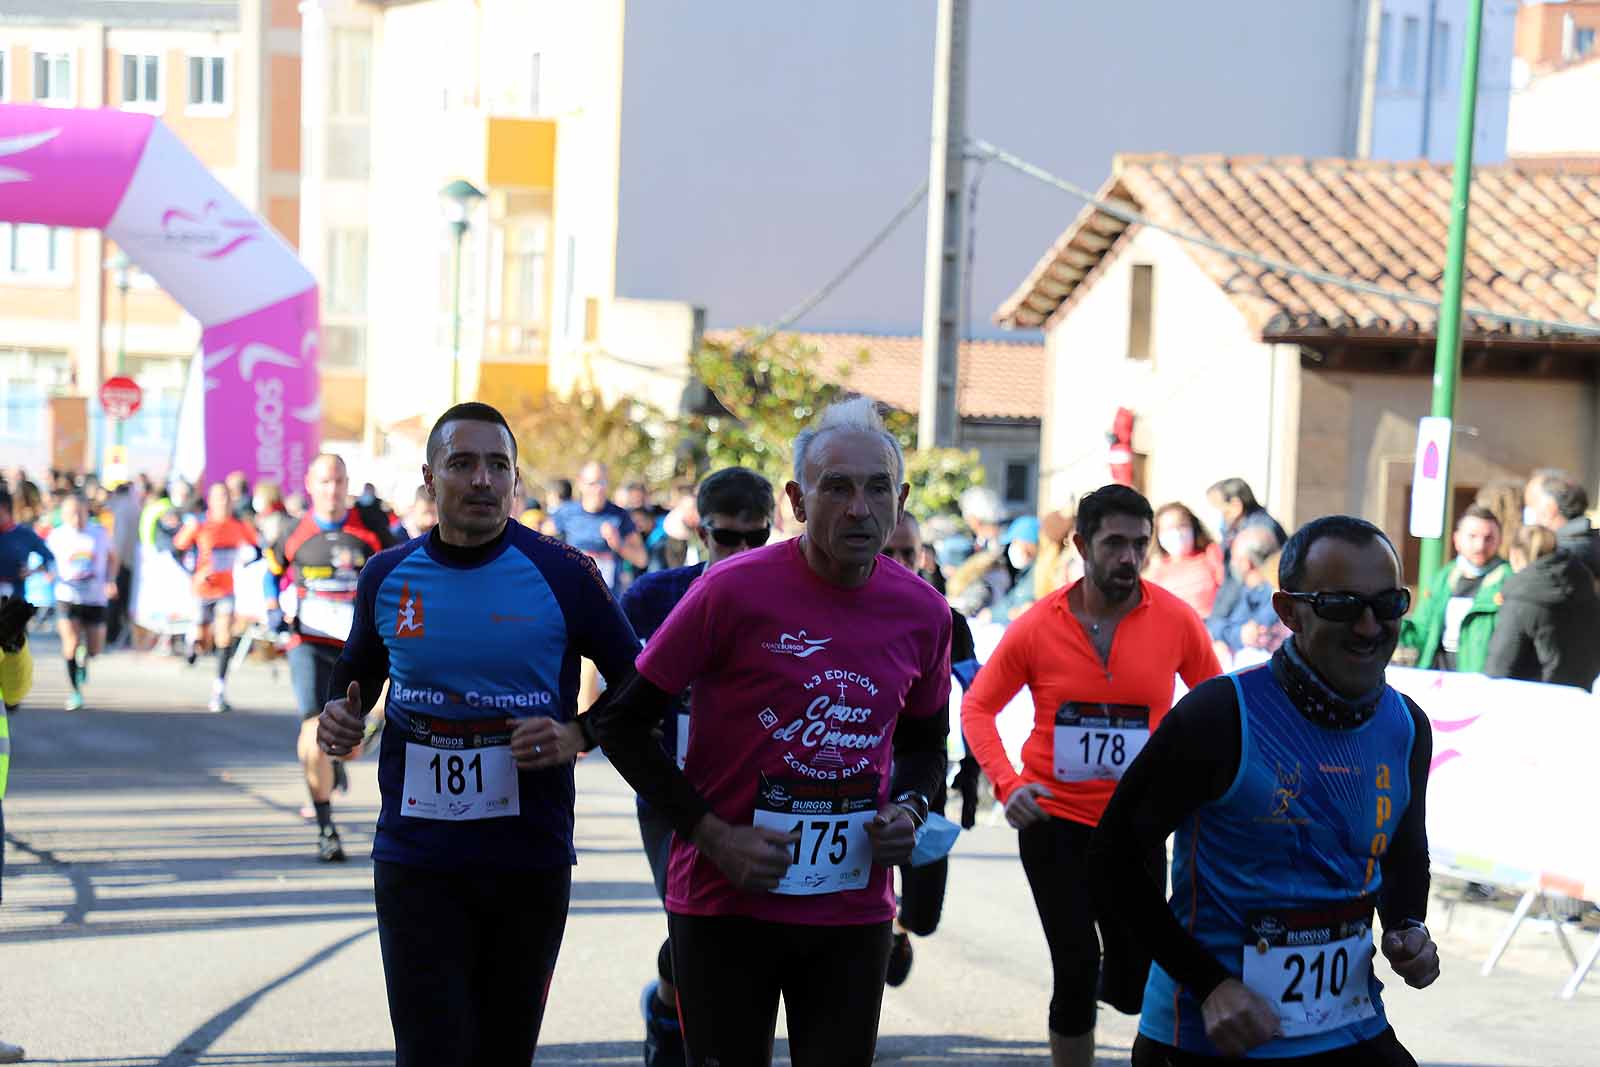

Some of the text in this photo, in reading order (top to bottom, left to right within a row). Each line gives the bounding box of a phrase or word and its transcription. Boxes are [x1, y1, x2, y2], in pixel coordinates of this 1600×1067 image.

[255, 377, 283, 484] URGOS
[394, 681, 551, 709] Barrio Cameno
[803, 669, 879, 697] 43 EDICIÓN
[805, 695, 872, 723] Cross
[772, 719, 804, 742] el
[1079, 731, 1125, 766] 178
[429, 753, 484, 795] 181
[783, 752, 870, 780] ZORROS RUN
[791, 800, 832, 810] BURGOS
[790, 820, 849, 865] 175
[1280, 946, 1348, 1003] 210
